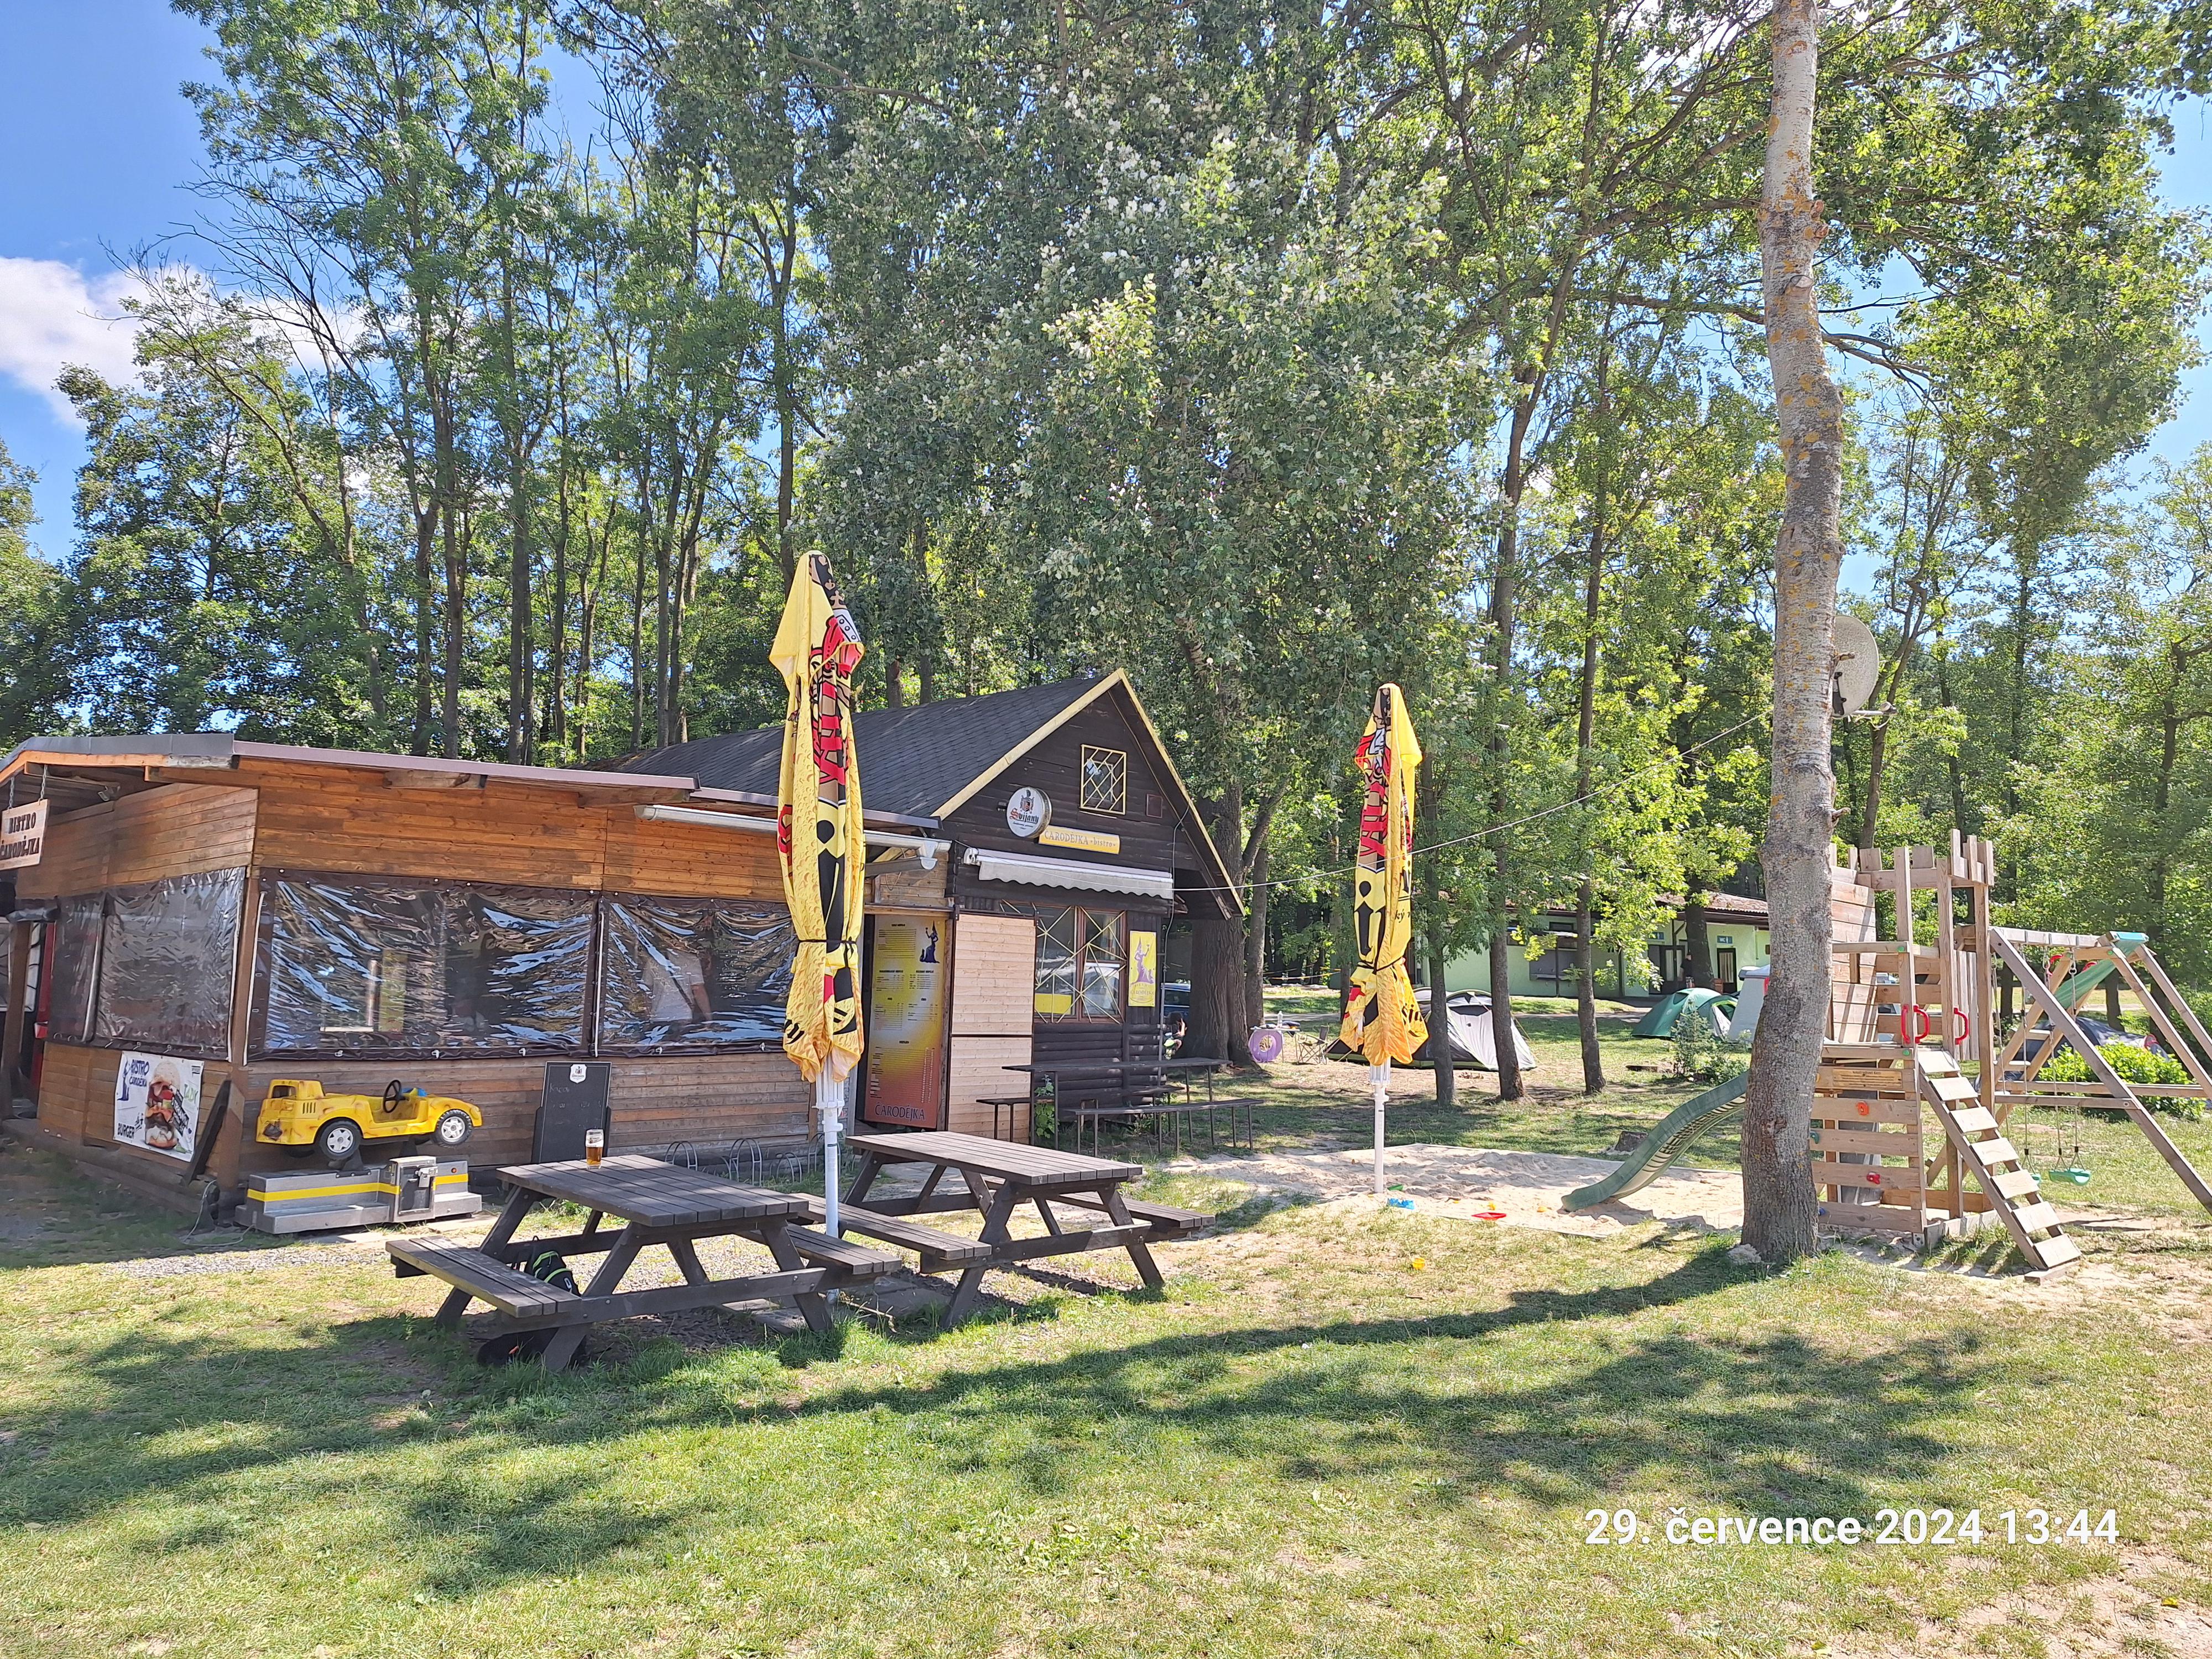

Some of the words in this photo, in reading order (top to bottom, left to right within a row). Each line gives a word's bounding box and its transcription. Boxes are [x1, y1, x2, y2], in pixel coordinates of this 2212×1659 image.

[8, 812, 36, 834] BISTRO
[1009, 807, 1039, 825] Svijany
[131, 1059, 150, 1076] BISTRO
[117, 1123, 135, 1139] BURGER
